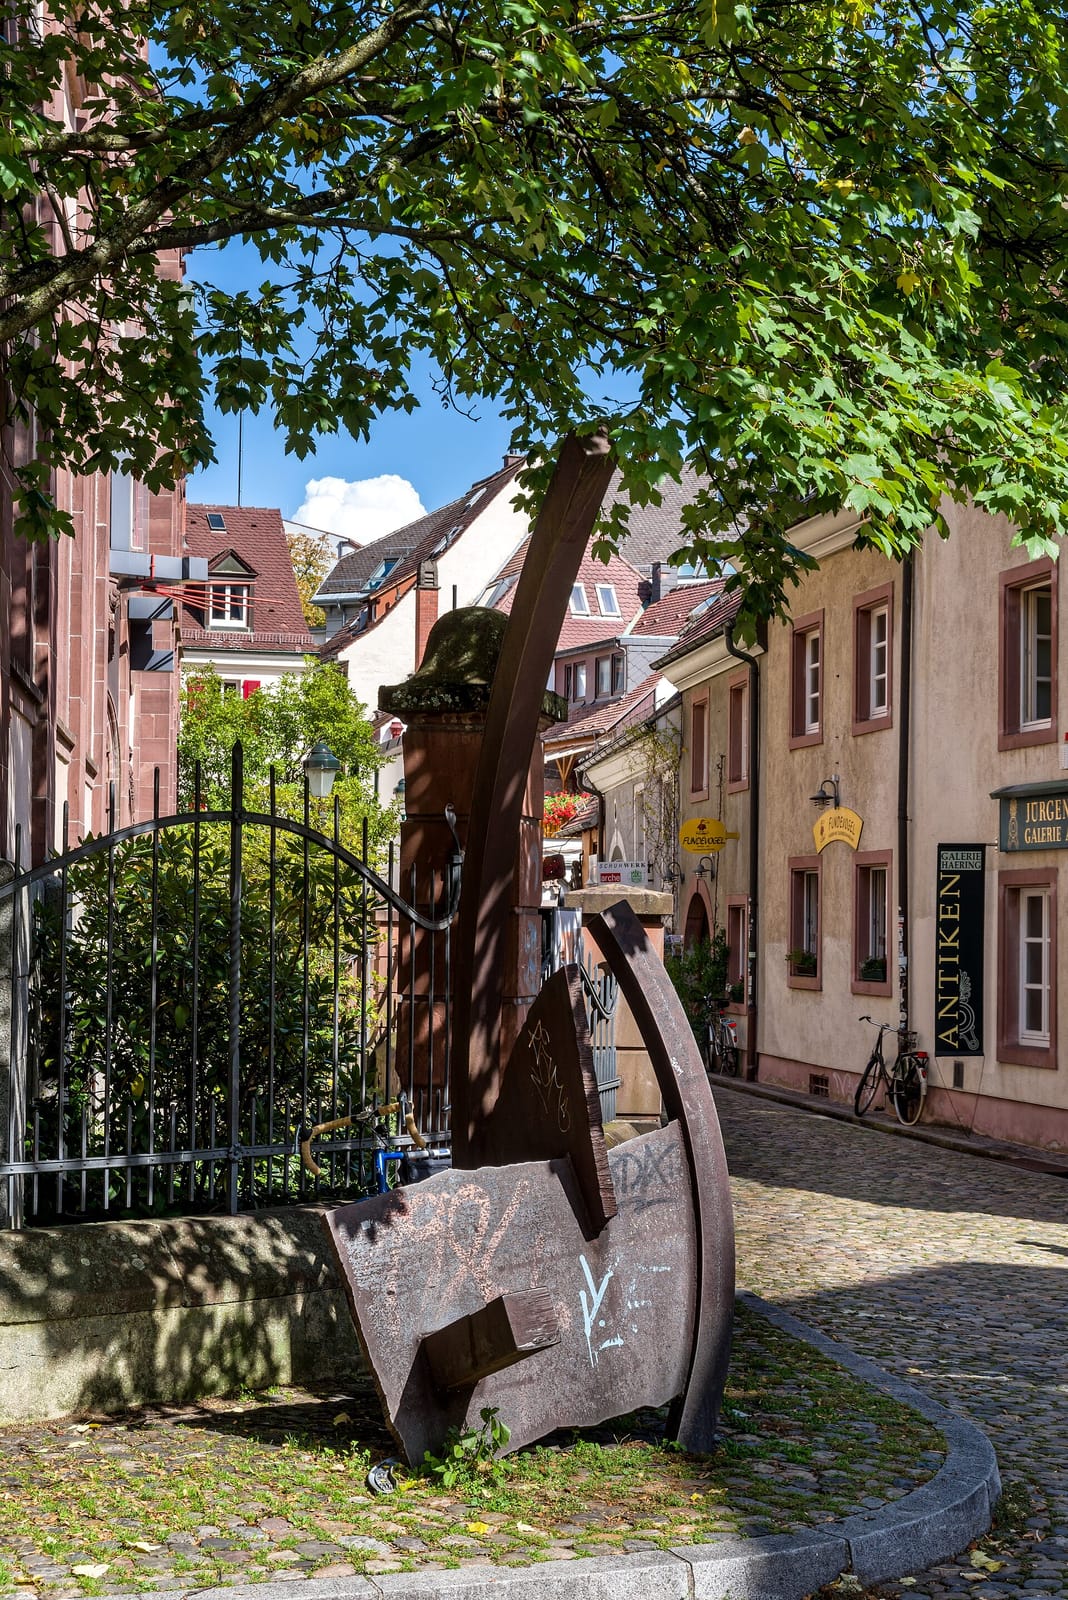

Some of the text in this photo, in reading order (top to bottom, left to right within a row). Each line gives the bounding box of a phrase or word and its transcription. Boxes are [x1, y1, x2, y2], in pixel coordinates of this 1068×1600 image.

[828, 815, 855, 835] FUNDEVOGEL
[682, 836, 726, 845] FUNDEVOGEL
[1024, 826, 1062, 844] GALERIE
[941, 852, 982, 861] GALERIE
[941, 861, 981, 869] HAERING
[938, 872, 961, 1048] ANTIKEN
